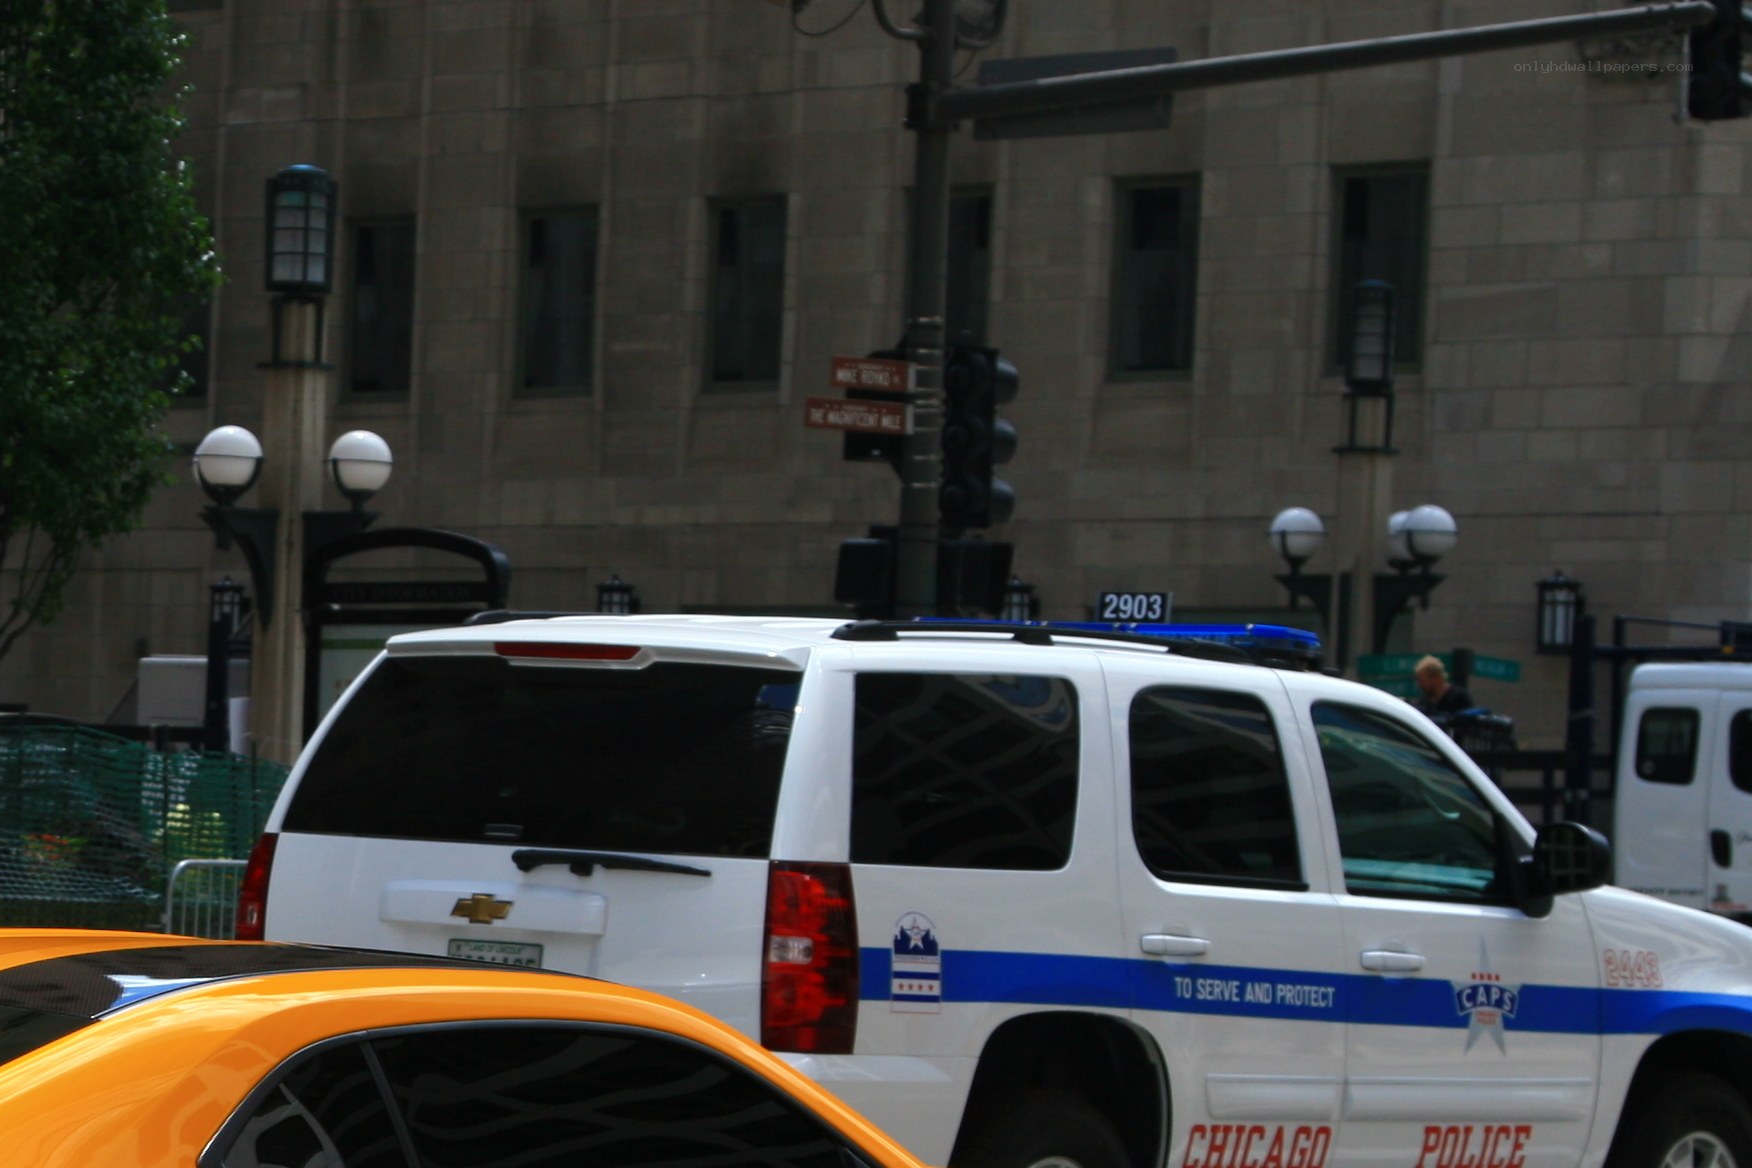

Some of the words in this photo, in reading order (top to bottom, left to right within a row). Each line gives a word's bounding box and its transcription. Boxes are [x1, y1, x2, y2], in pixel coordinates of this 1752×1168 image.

[1103, 593, 1162, 620] 2903
[1604, 948, 1662, 988] 2443
[1174, 977, 1192, 999] TO
[1196, 977, 1241, 1002] SERVE
[1245, 982, 1273, 1004] AND
[1277, 983, 1335, 1008] PROTECT
[1462, 986, 1513, 1012] CAPS
